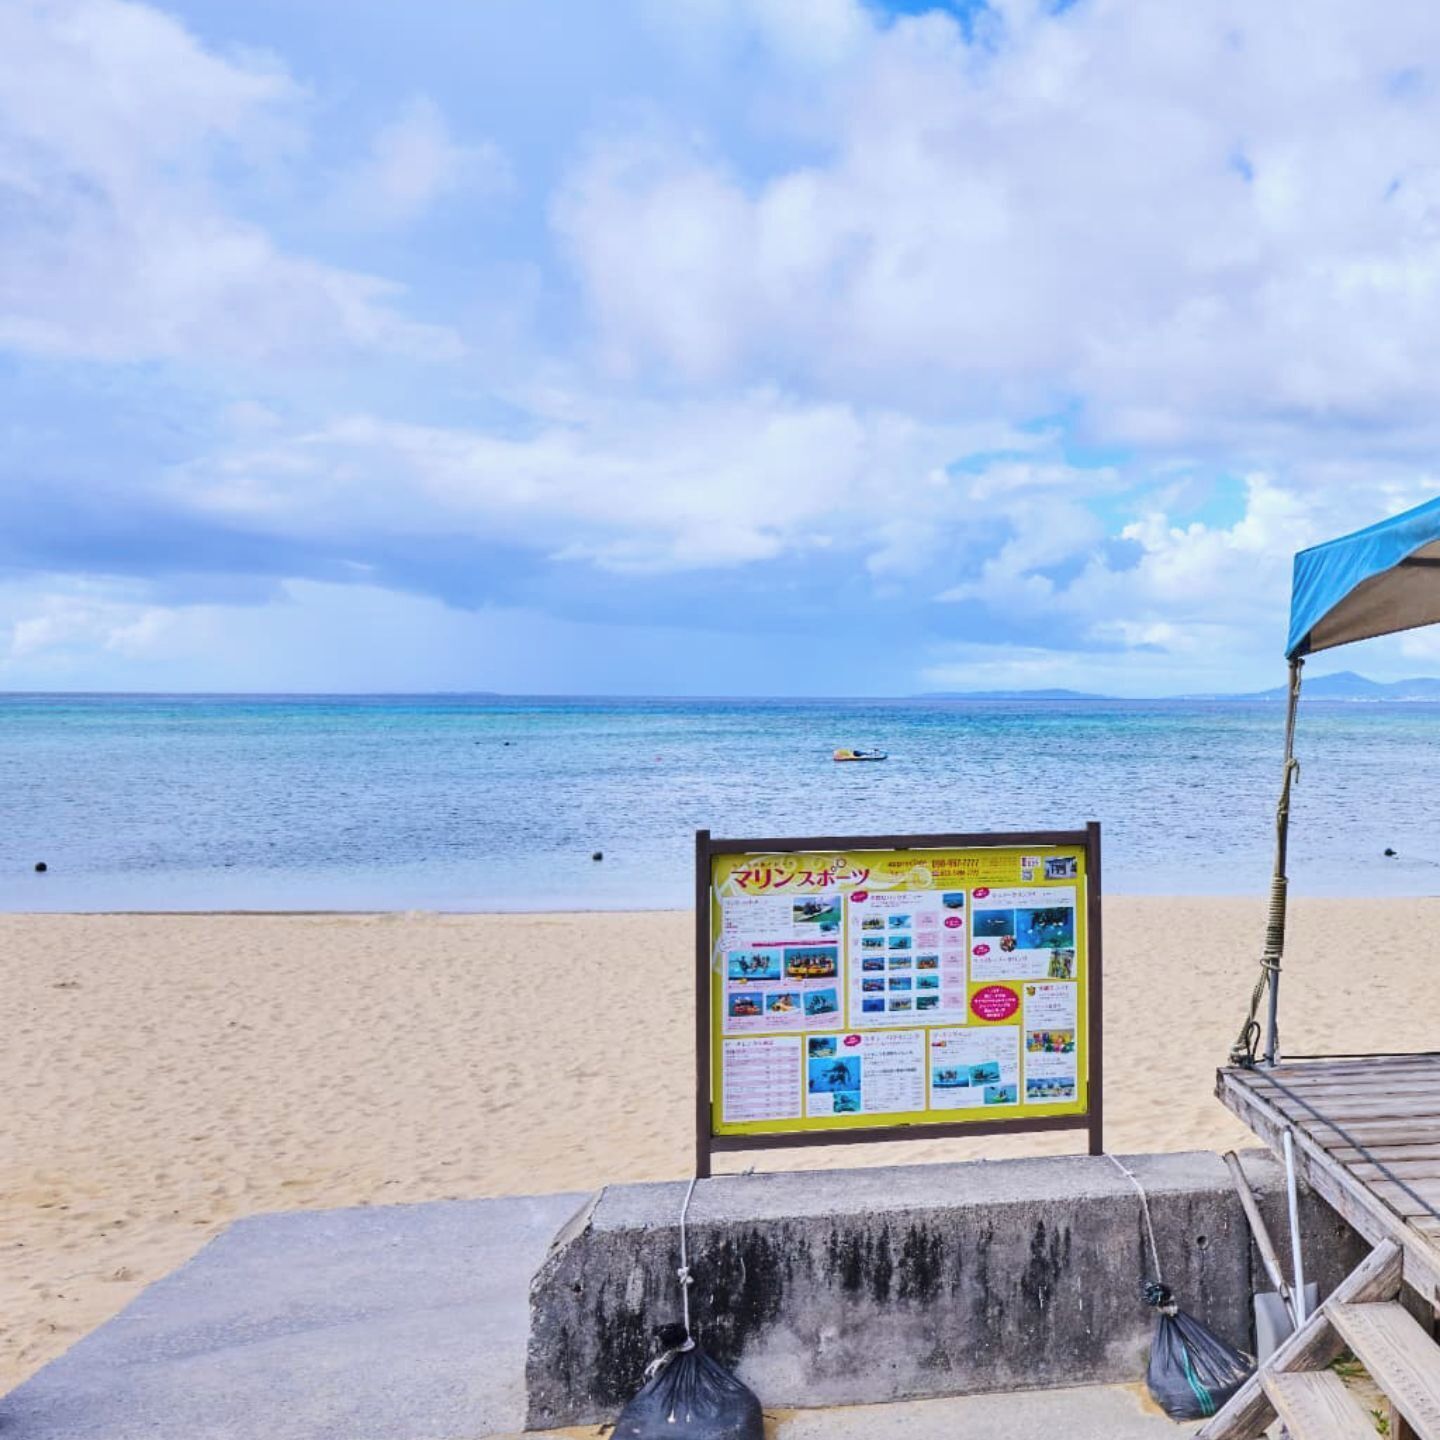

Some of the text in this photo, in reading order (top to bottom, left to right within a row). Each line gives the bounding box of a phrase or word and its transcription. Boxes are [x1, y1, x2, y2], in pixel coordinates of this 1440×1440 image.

[731, 864, 870, 890] マリンスポーツ
